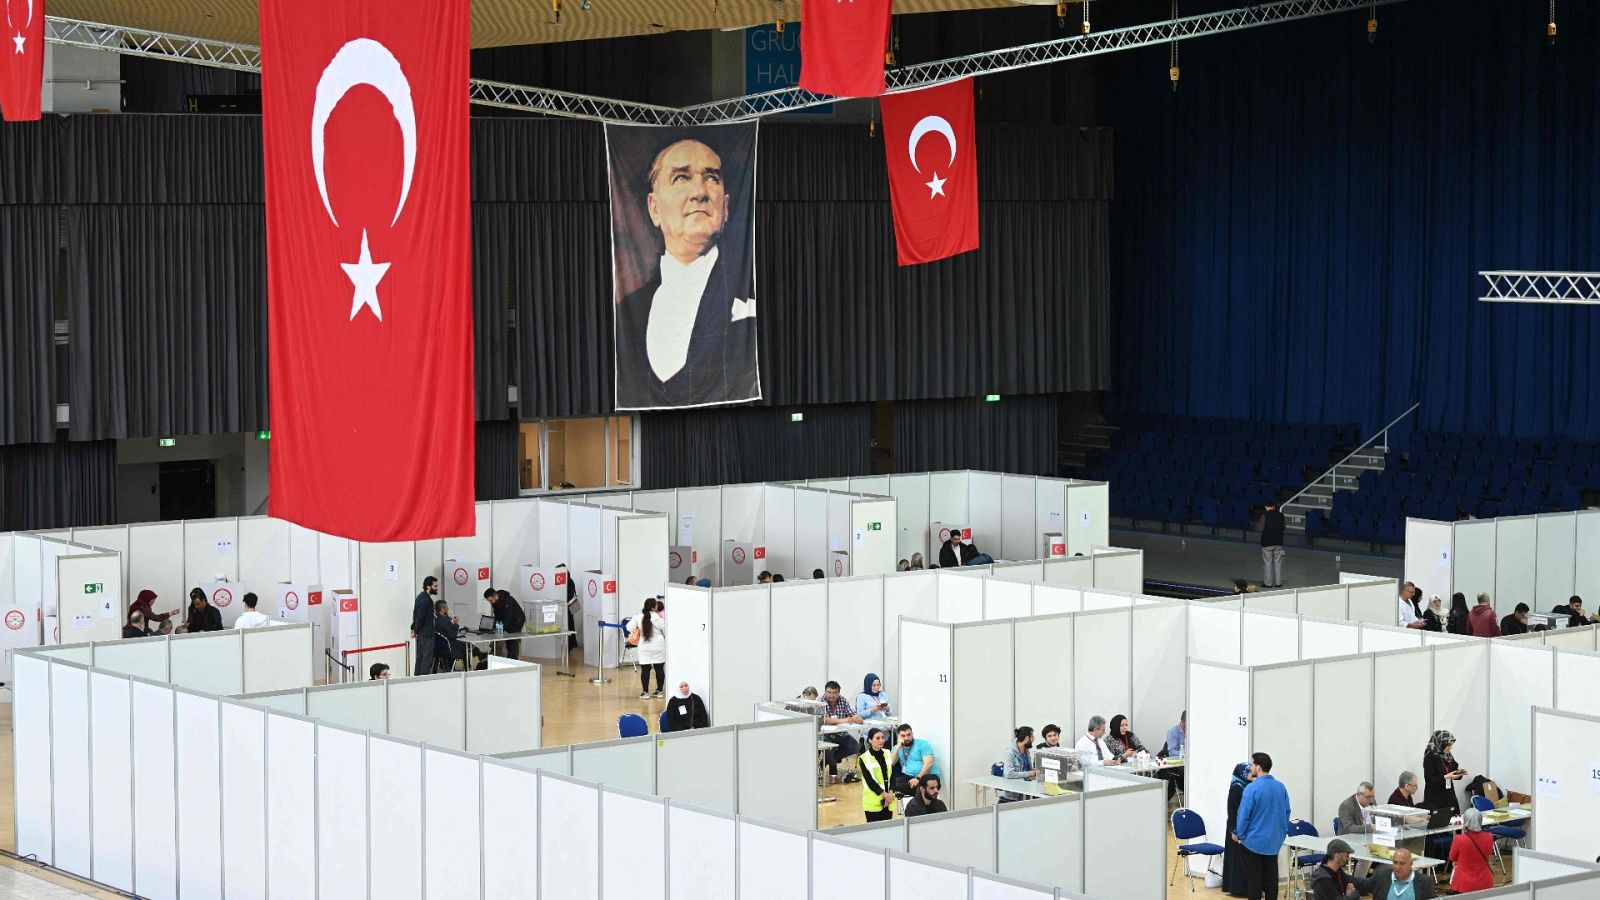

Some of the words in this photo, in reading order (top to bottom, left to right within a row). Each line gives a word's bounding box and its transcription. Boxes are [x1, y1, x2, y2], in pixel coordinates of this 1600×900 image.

[751, 29, 801, 52] GRU
[389, 564, 395, 572] 3
[104, 602, 110, 610] 4
[939, 674, 948, 683] 11
[1238, 716, 1247, 727] 15
